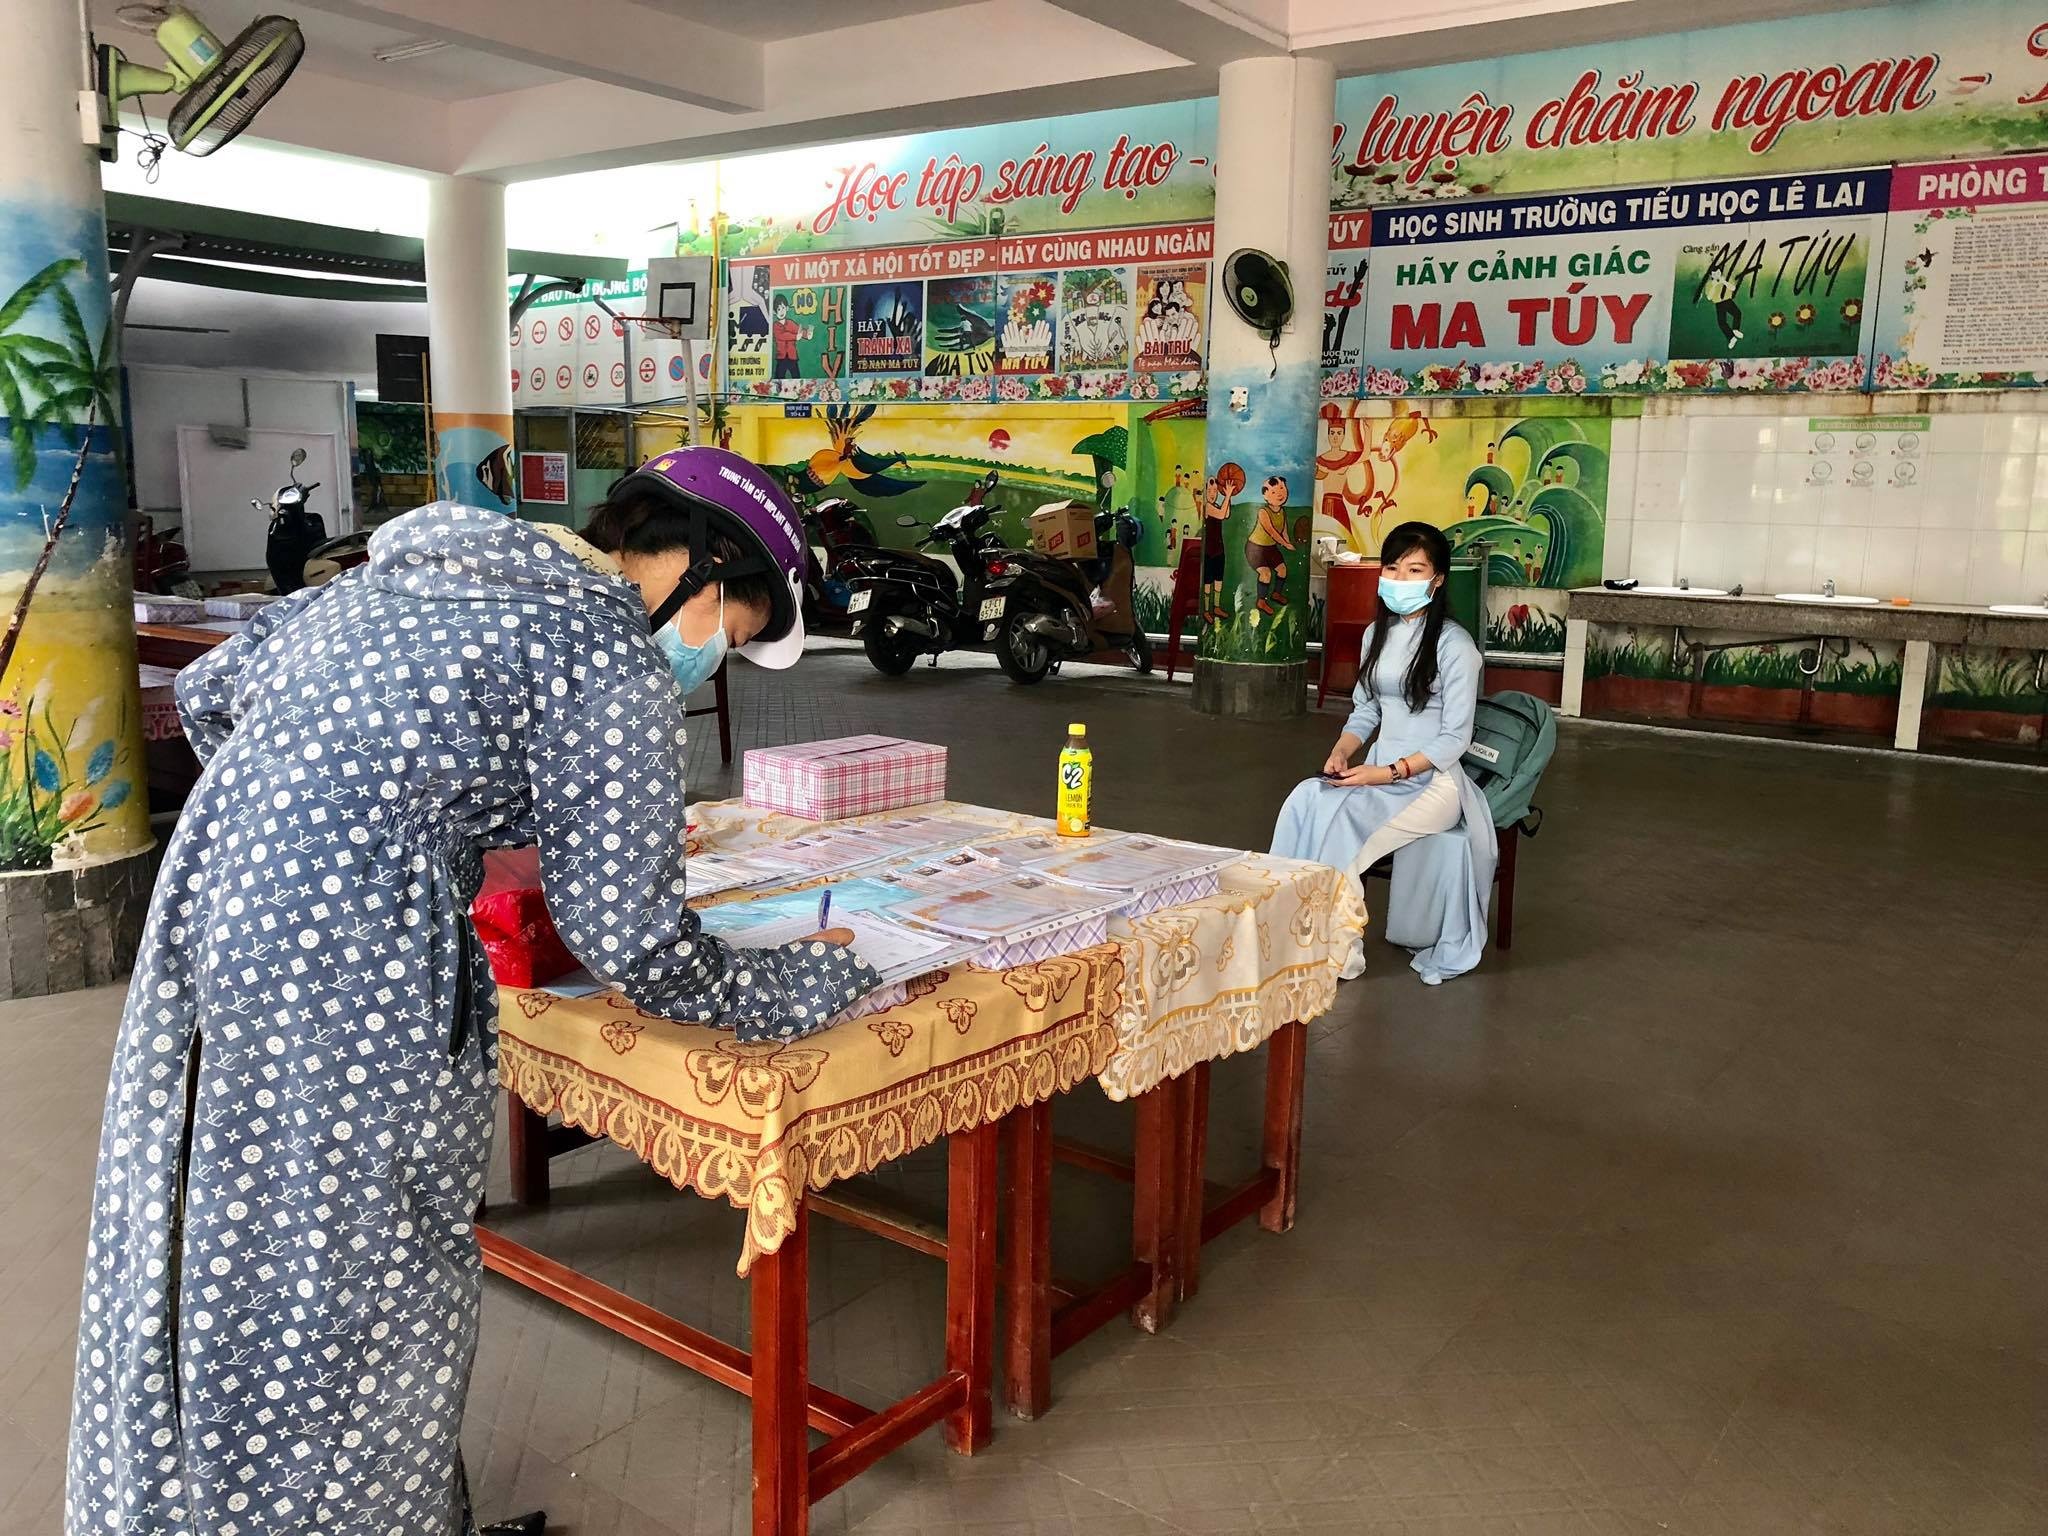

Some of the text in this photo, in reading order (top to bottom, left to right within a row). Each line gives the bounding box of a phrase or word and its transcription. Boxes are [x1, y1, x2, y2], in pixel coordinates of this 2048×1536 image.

[1356, 91, 1511, 188] luyện
[1525, 68, 1699, 151] chăm
[1711, 50, 1941, 155] ngoan
[812, 161, 909, 236] Học
[915, 152, 984, 225] tập
[991, 141, 1096, 215] sáng
[1103, 133, 1182, 201] tạo
[1917, 164, 2028, 202] PHÒNG
[1388, 179, 1867, 244] HỌC SINH TRƯỜNG TIỂU HỌC LÊ LAI
[783, 259, 803, 281] VÌ
[804, 256, 840, 283] MỘT
[844, 254, 868, 277] XÃ
[872, 251, 903, 279] HỘI
[908, 243, 944, 274] TỐT
[947, 247, 986, 280] ĐẸP
[1001, 237, 1038, 265] HÃY
[1041, 237, 1093, 263] CÙNG
[1097, 234, 1149, 259] NHAU
[1154, 228, 1212, 255] NGĂN
[1395, 245, 1652, 287] HÃY CẢNH GIÁC
[1770, 229, 1857, 299] TÚY
[796, 293, 814, 310] NO
[1388, 281, 1654, 351] MA TÚY
[856, 332, 913, 357] TRÁNH XA
[857, 319, 884, 333] HÃY
[1143, 337, 1193, 356] BÀI TRỪ
[718, 466, 742, 485] TRUNG
[739, 478, 755, 496] TÂM
[752, 488, 767, 504] CẤY
[1062, 763, 1084, 790] C2
